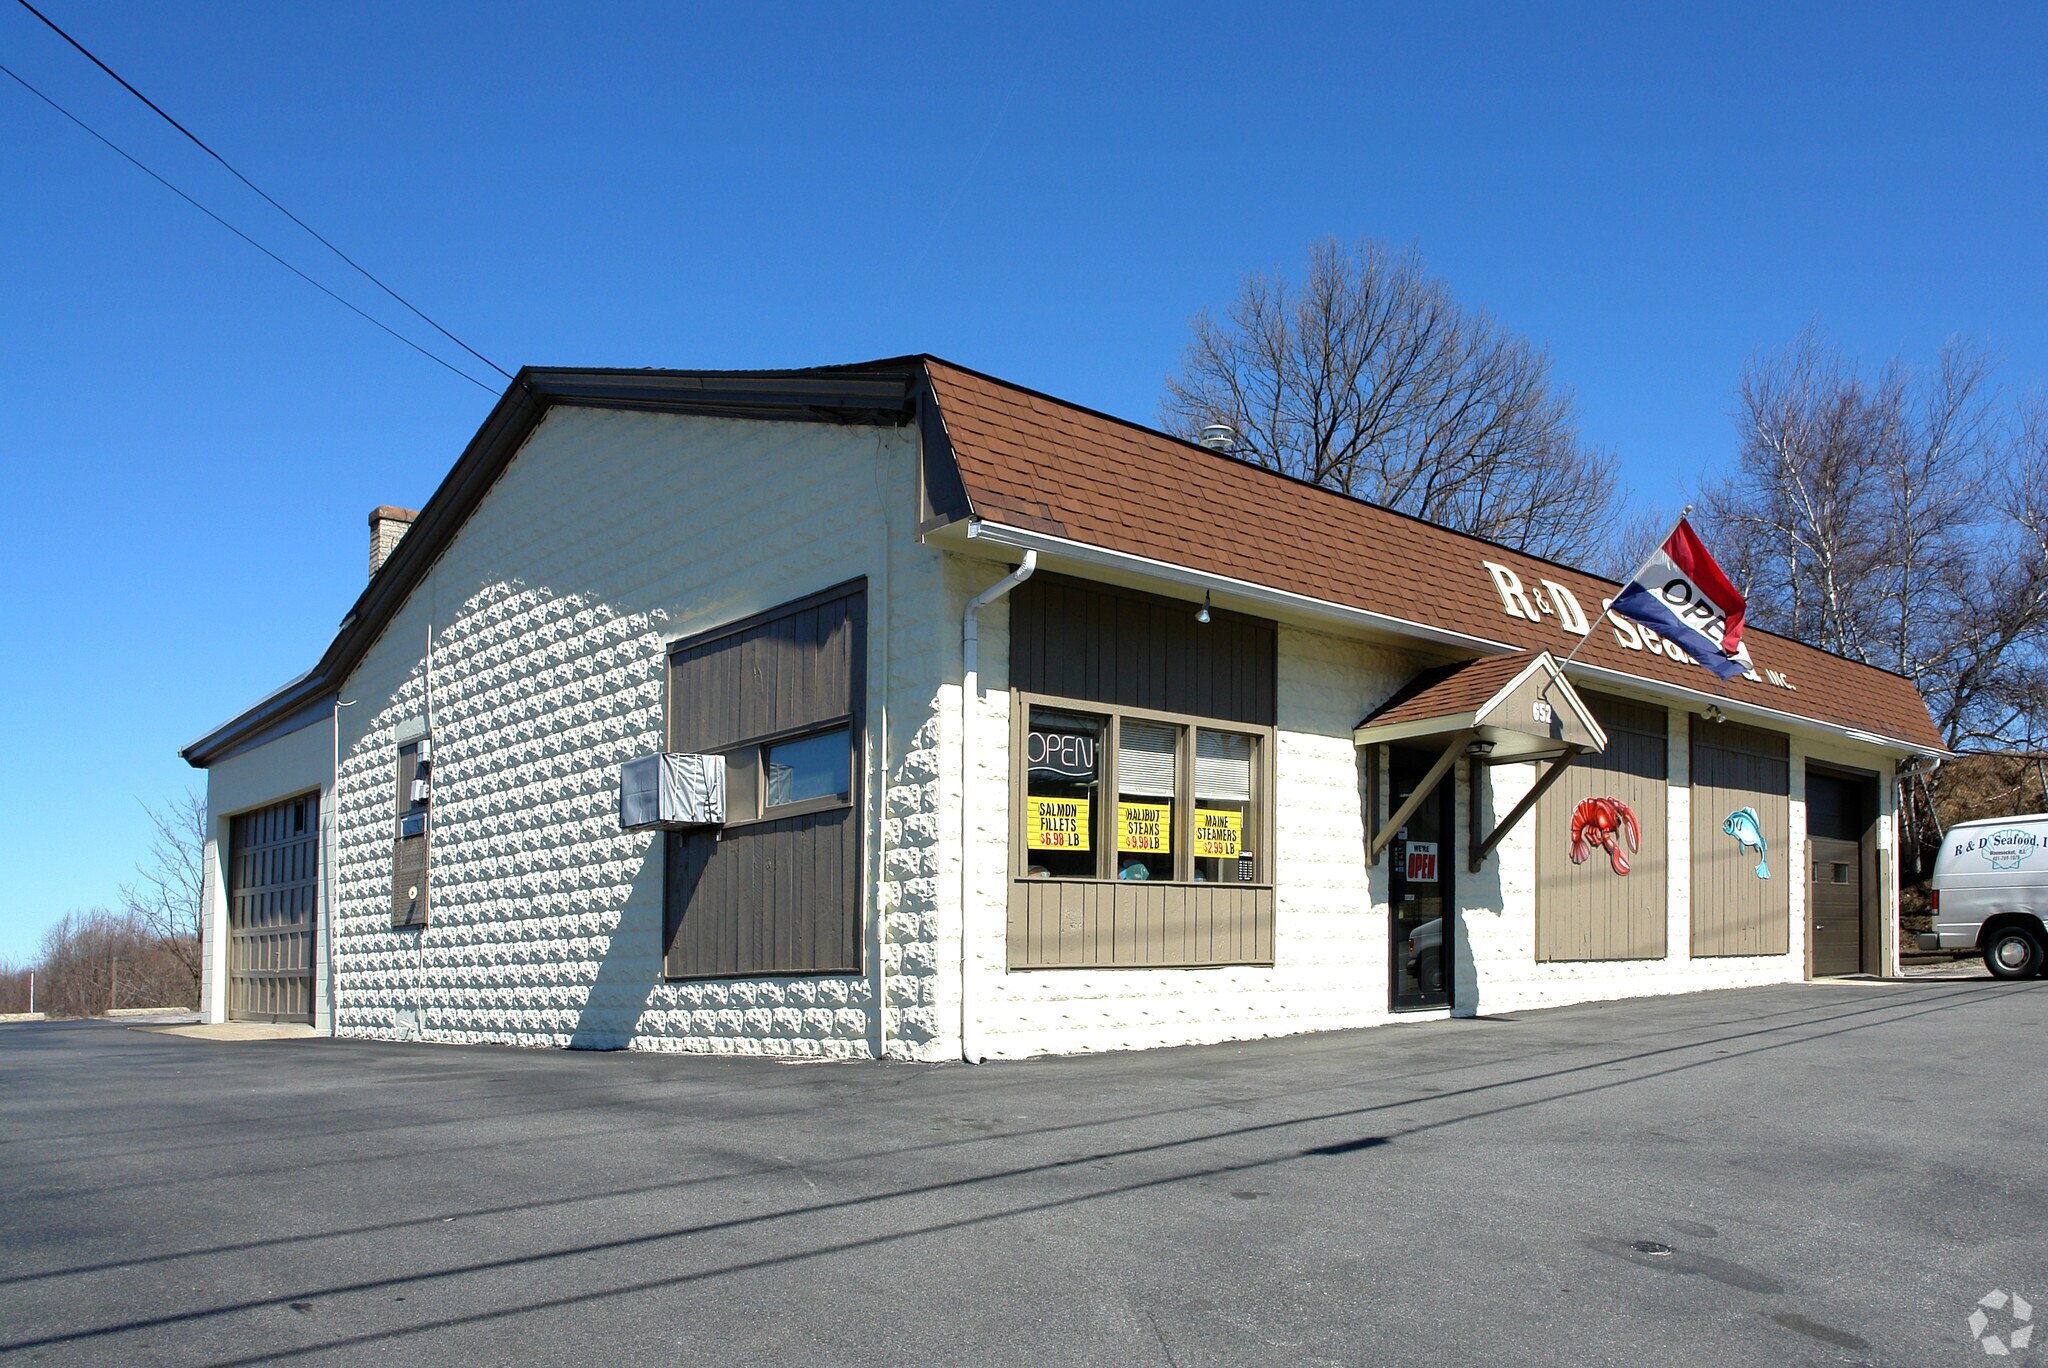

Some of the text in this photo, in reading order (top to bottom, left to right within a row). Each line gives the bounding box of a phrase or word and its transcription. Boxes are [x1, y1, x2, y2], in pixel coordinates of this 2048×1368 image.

[1662, 578, 1727, 642] OPE
[1532, 701, 1552, 724] 652
[1027, 731, 1093, 768] OPEN
[1040, 803, 1077, 817] SALMON
[1126, 808, 1160, 822] HALIBUT
[1040, 818, 1076, 832] FILLETS
[1205, 815, 1229, 828] MAINE
[1040, 832, 1080, 846] $6.98 LB
[1197, 828, 1237, 841] STEAMERS
[1126, 836, 1160, 849] $9.98 LB
[1204, 841, 1235, 855] $2.99 LB
[1954, 845, 1963, 857] R
[1966, 841, 1975, 852] &
[1978, 838, 1988, 849] D
[1993, 834, 2040, 849] Seafood,
[1408, 853, 1435, 879] OPEN
